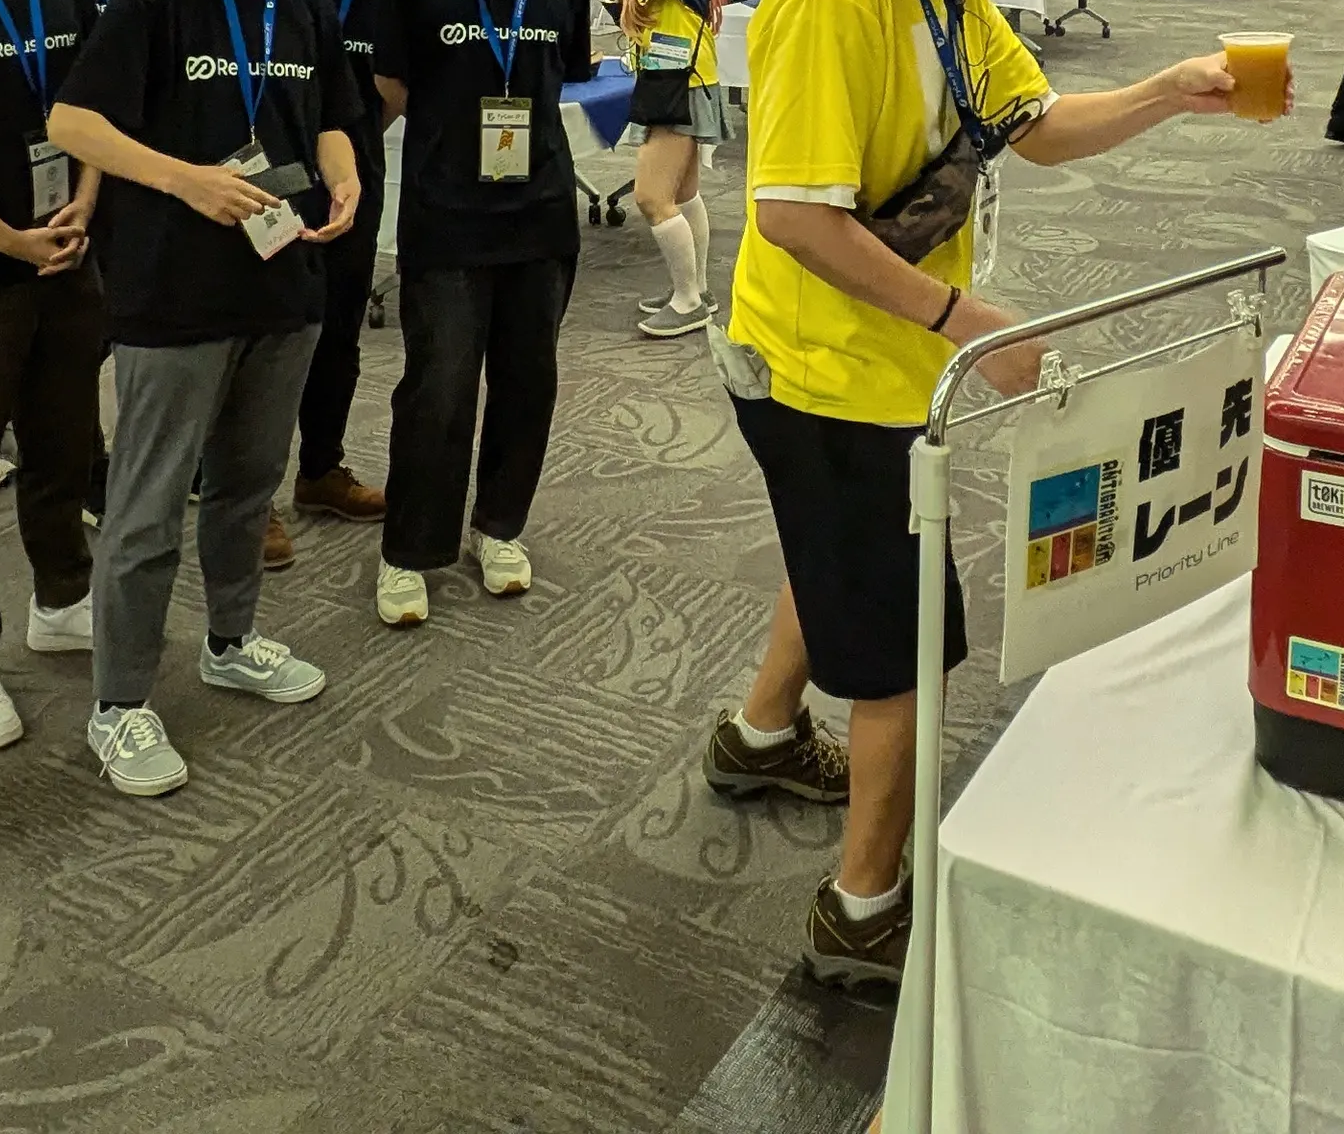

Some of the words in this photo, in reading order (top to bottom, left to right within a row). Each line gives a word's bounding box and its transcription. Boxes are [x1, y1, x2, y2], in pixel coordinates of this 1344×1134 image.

[218, 59, 314, 80] Reustomer
[1132, 456, 1250, 563] レーン
[1136, 550, 1204, 591] Priority
[1207, 530, 1240, 559] Line
